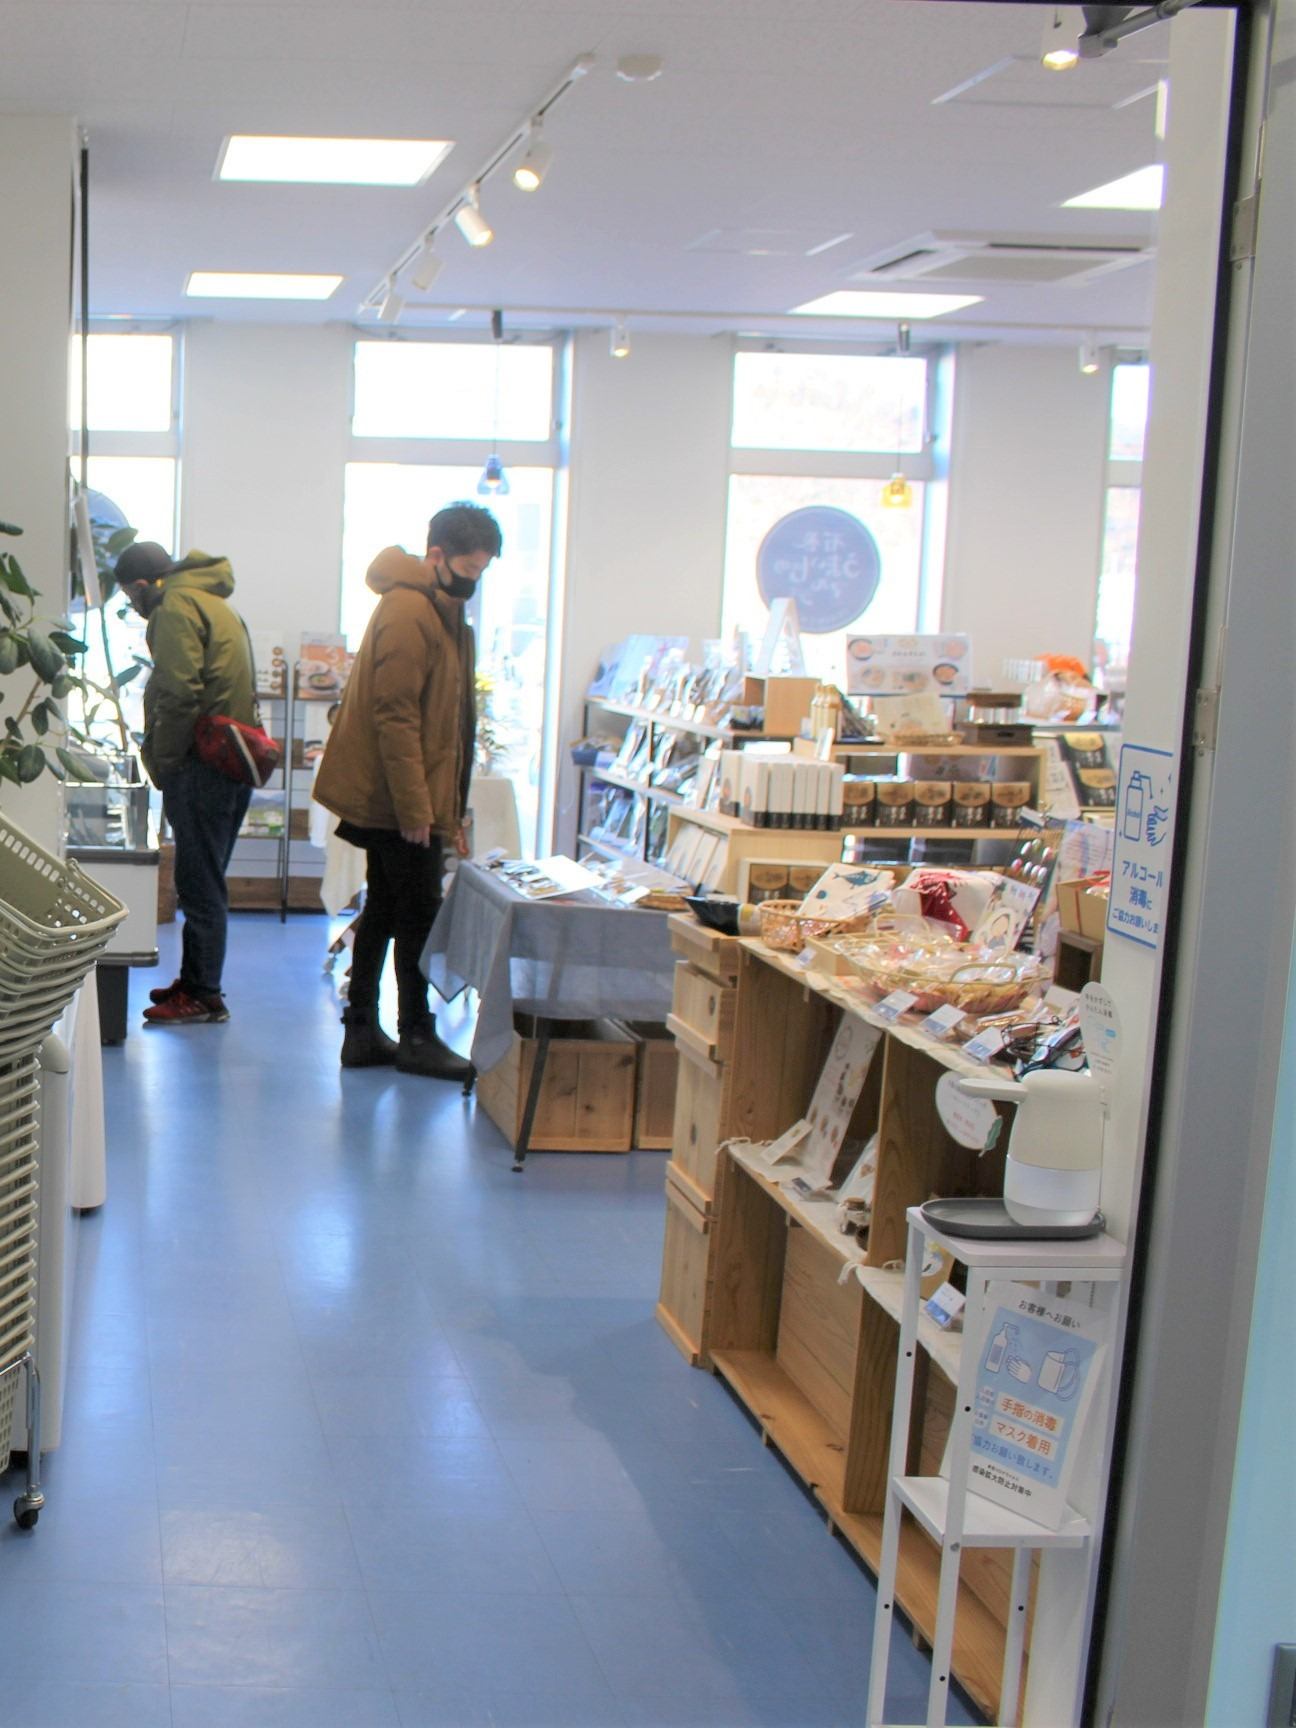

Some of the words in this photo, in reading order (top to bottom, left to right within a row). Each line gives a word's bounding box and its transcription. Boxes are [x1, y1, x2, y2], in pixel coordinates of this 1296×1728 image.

[1122, 860, 1164, 888] アルコール
[1128, 886, 1153, 910] 消毒に
[1018, 1299, 1081, 1330] お客様へお願い
[1001, 1397, 1058, 1432] 手指の消毒
[996, 1421, 1052, 1456] マスク着用
